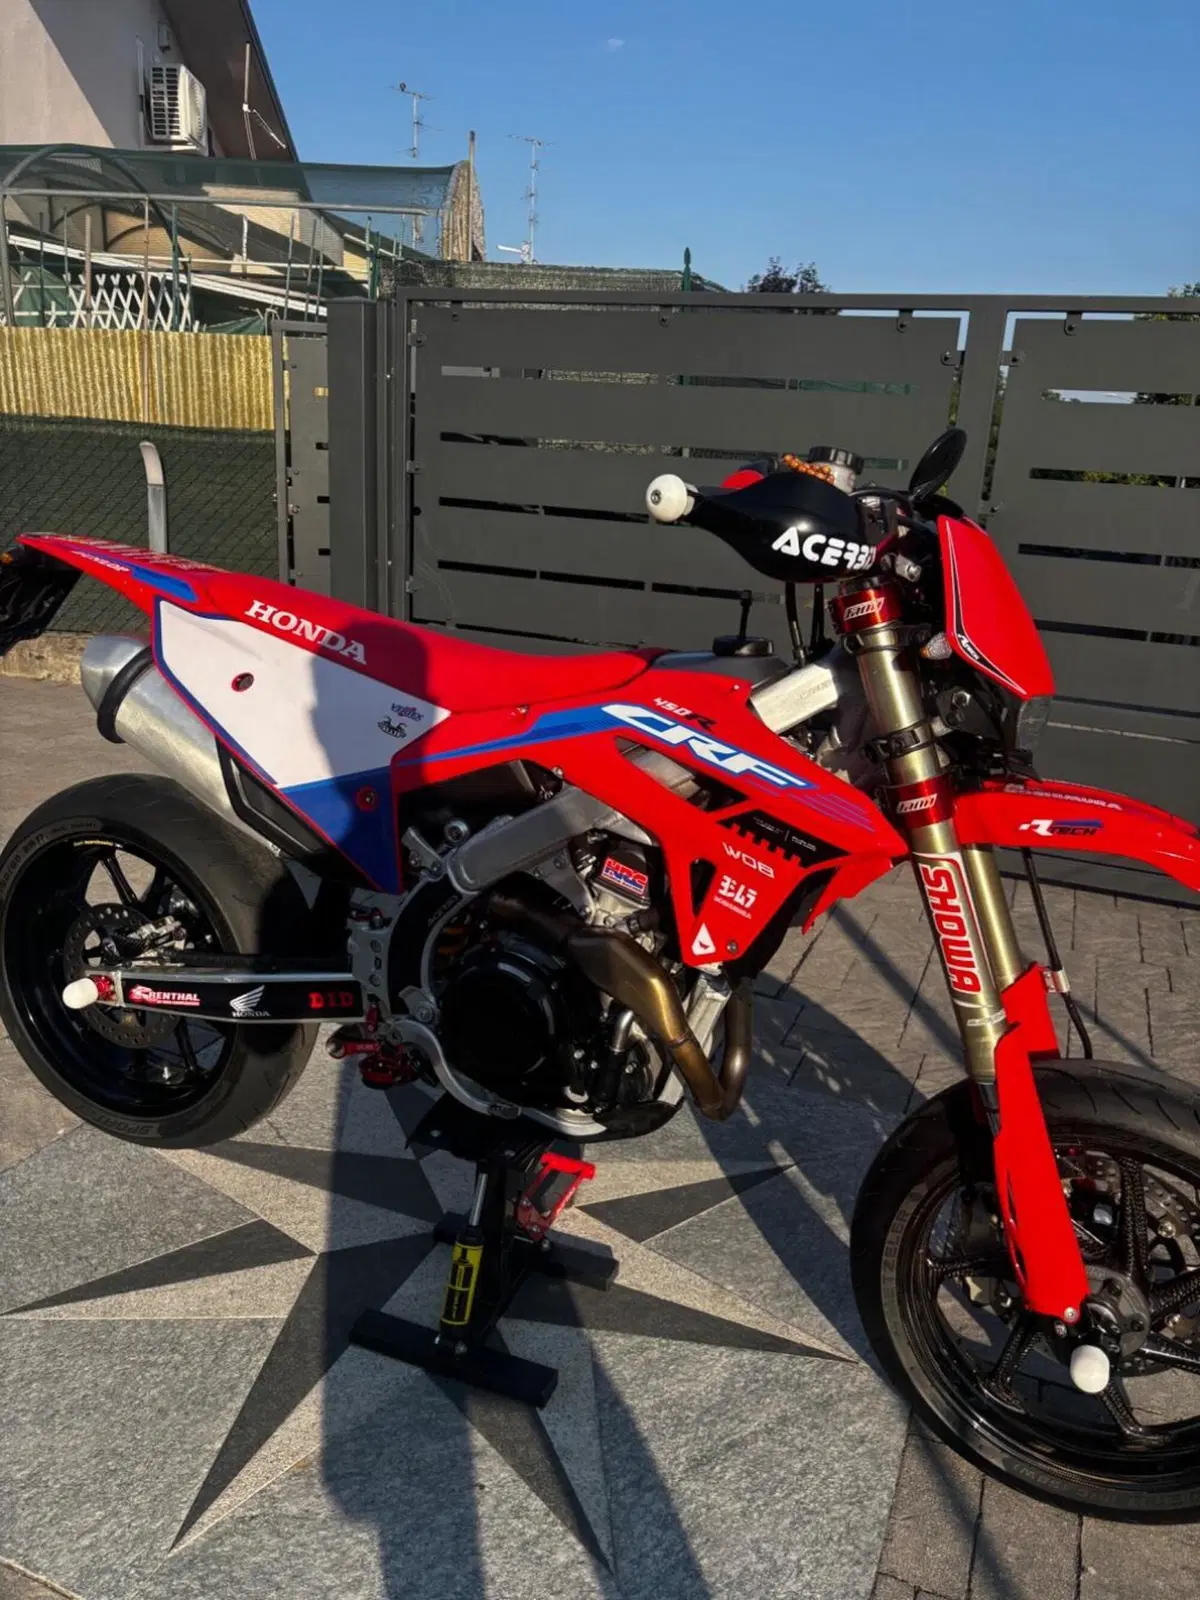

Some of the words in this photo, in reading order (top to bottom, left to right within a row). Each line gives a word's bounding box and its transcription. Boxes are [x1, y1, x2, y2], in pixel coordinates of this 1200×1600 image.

[244, 600, 367, 665] HONDA
[601, 703, 807, 787] CRF
[604, 858, 649, 890] HRC
[919, 863, 982, 995] SHOWA
[232, 1009, 270, 1018] HONDA
